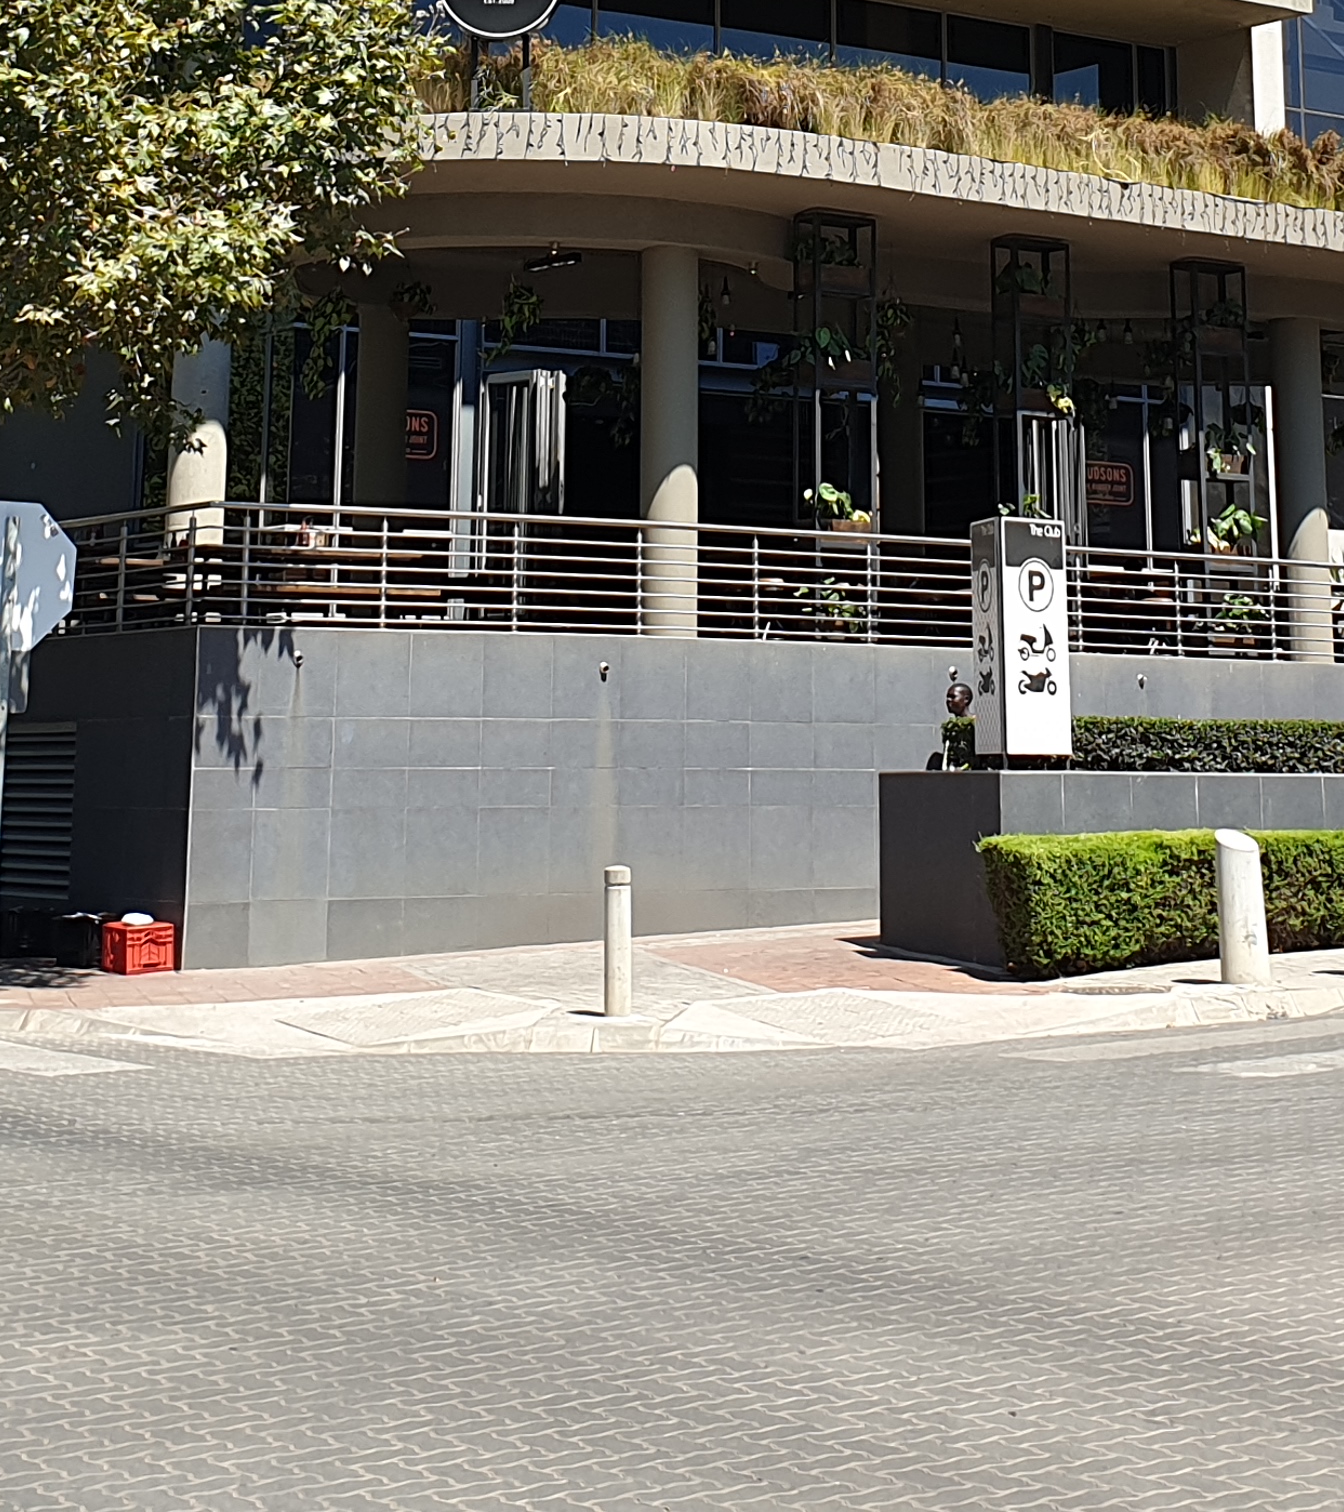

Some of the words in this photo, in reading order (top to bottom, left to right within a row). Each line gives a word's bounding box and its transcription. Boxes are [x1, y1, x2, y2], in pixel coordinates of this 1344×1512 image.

[1087, 466, 1127, 483] UDSONS
[1029, 523, 1044, 537] The
[1044, 524, 1061, 539] Club
[980, 570, 989, 604] P
[1028, 570, 1046, 602] P
